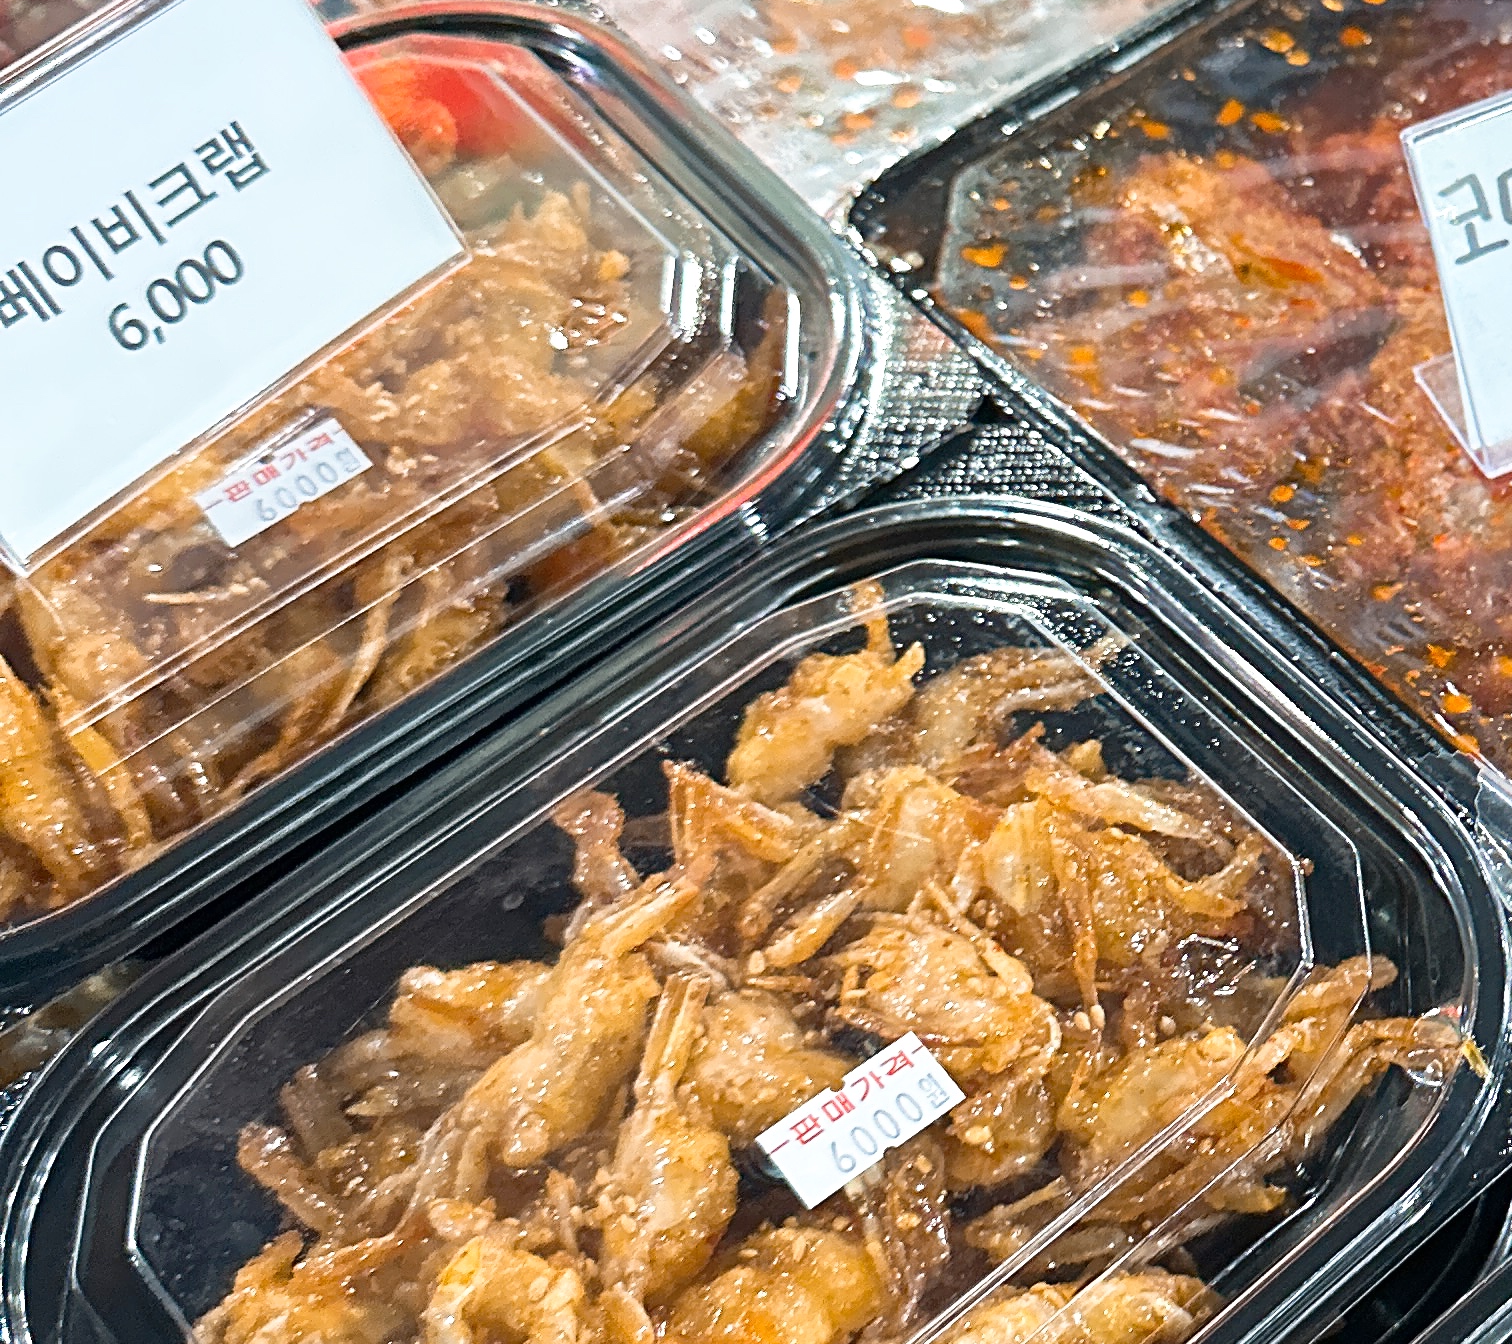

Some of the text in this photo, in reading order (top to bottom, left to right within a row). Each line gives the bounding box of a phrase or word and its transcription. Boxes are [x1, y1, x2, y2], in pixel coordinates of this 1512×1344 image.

[0, 120, 271, 329] 베이비크랩
[108, 239, 245, 351] 6,000
[789, 1050, 915, 1145] 판매가격
[831, 1073, 950, 1173] 6000원
